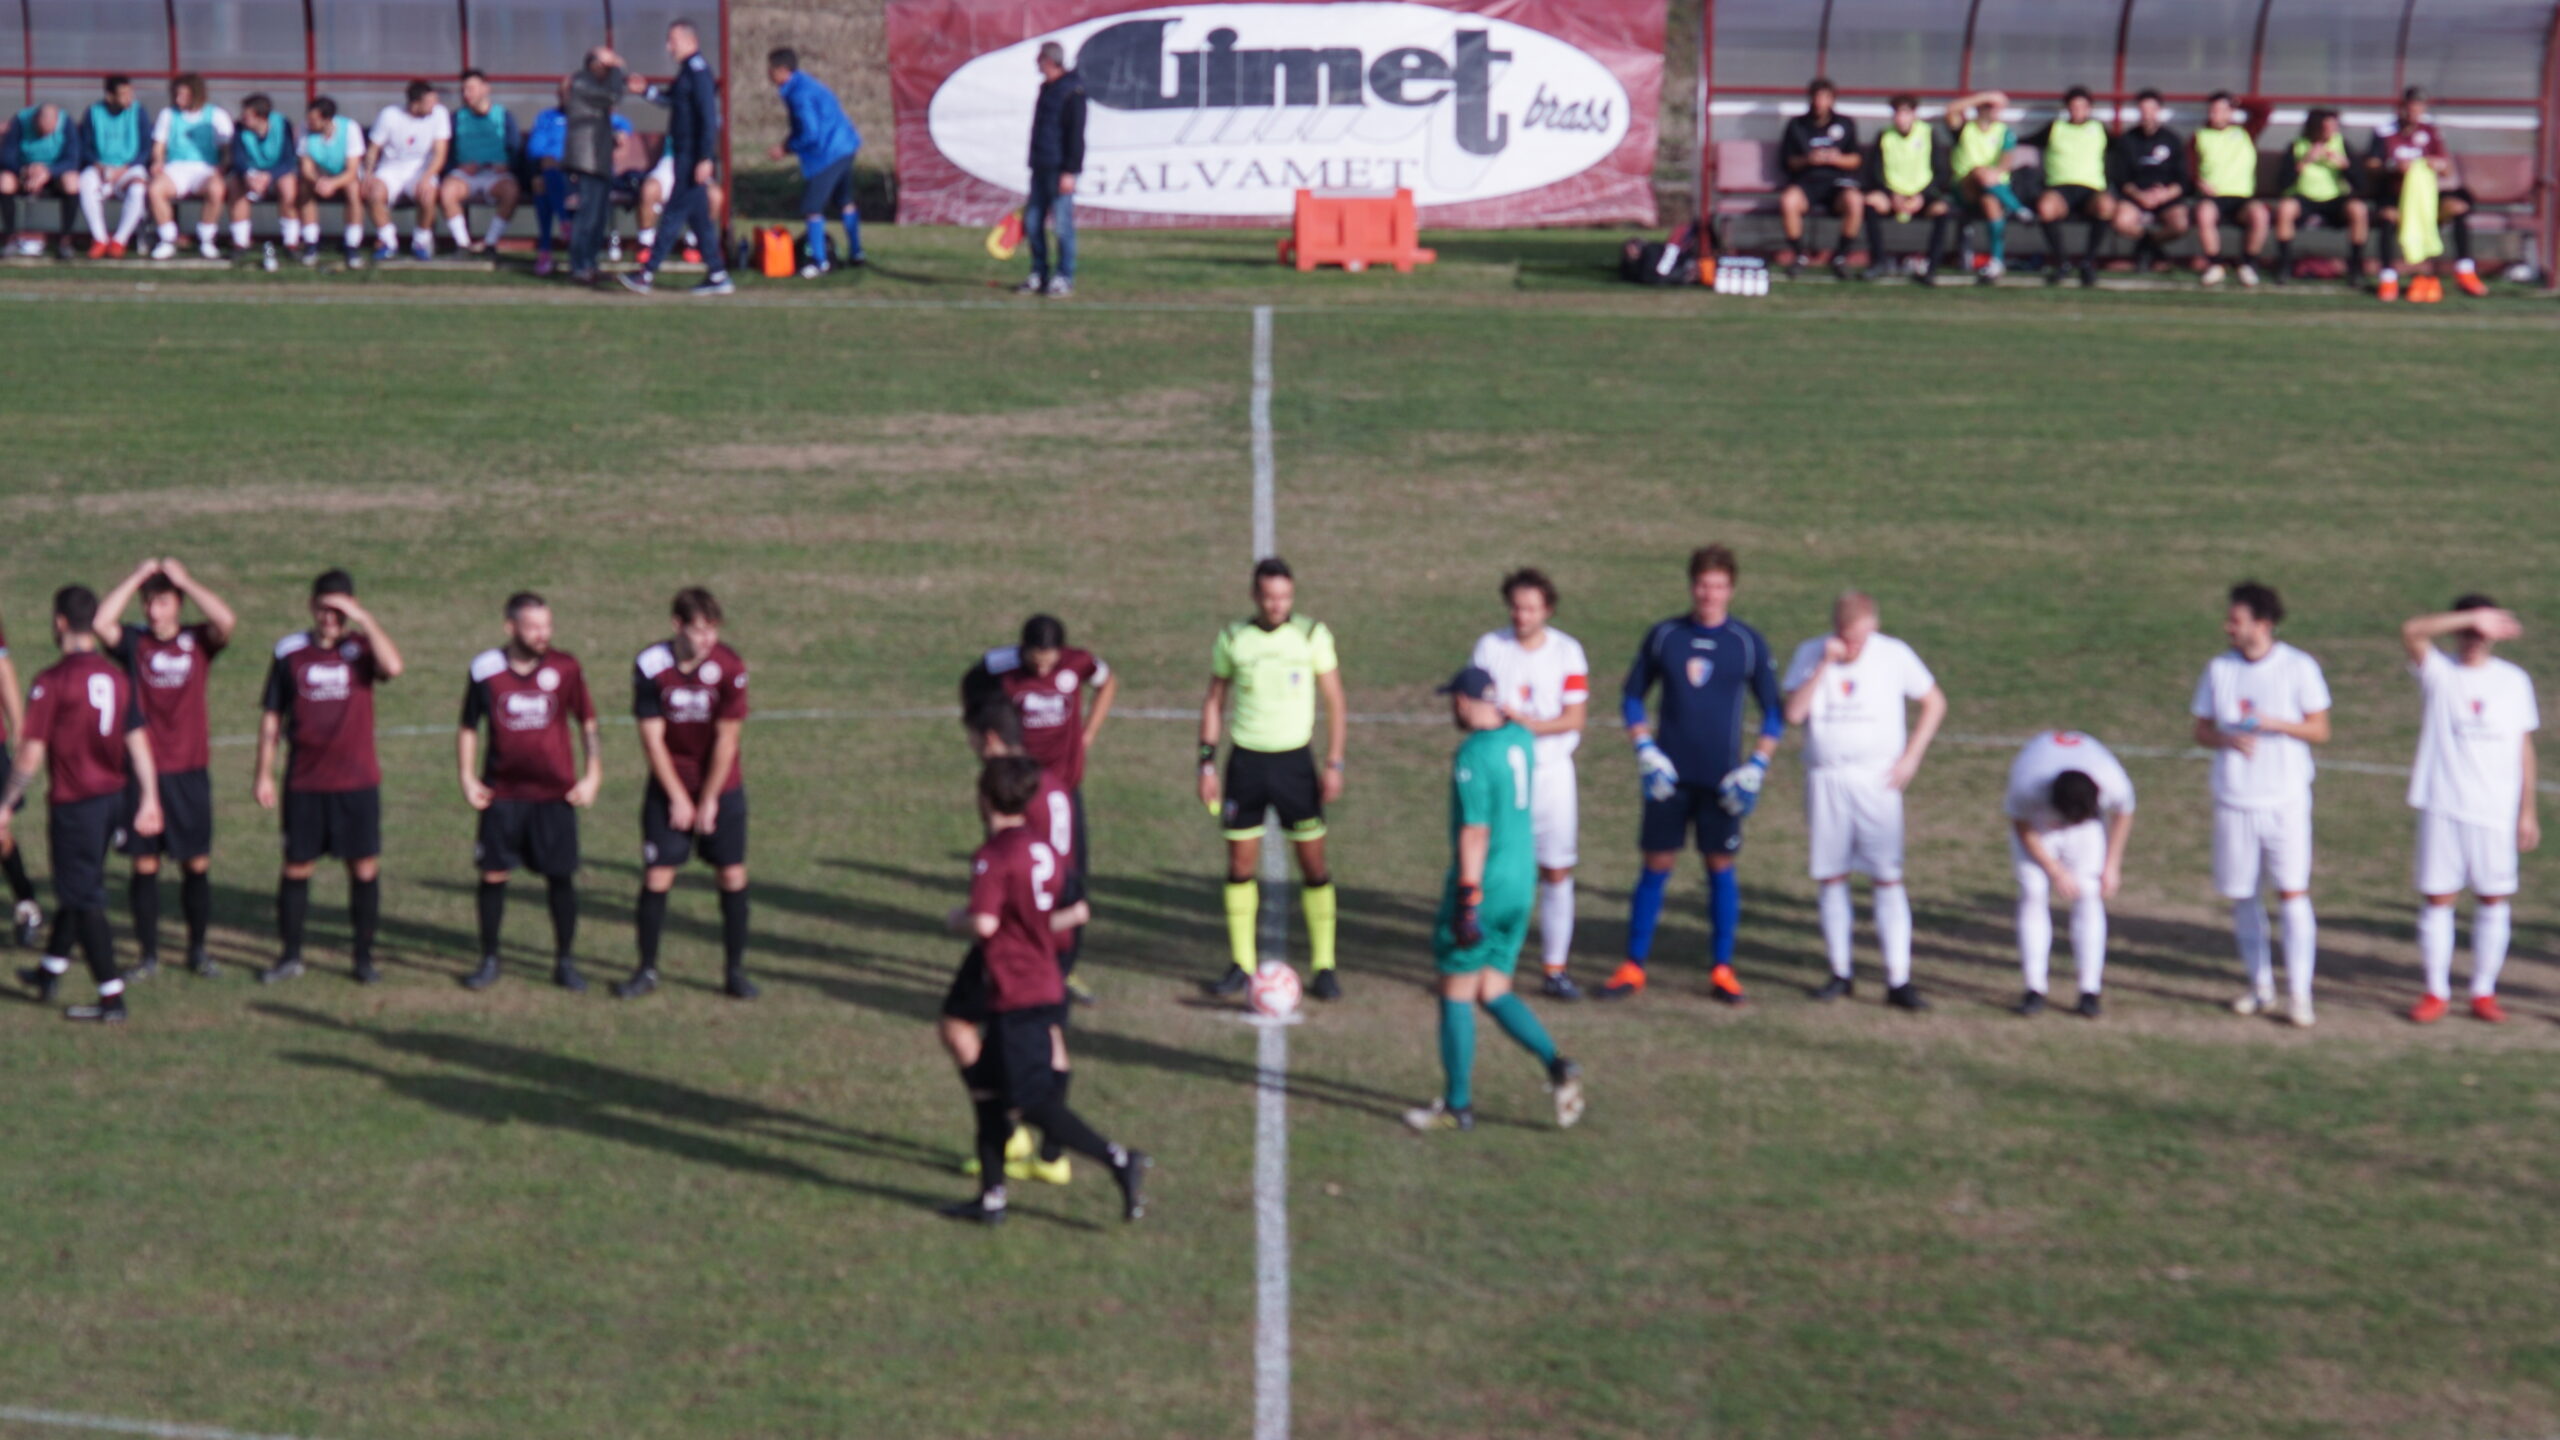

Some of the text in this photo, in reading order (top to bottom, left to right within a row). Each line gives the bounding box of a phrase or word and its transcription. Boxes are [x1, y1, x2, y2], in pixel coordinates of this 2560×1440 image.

[1522, 82, 1612, 133] brass
[1080, 158, 1418, 196] GALVAMET
[87, 672, 115, 736] 9
[1506, 744, 1528, 810] 1
[1028, 841, 1056, 912] 2
